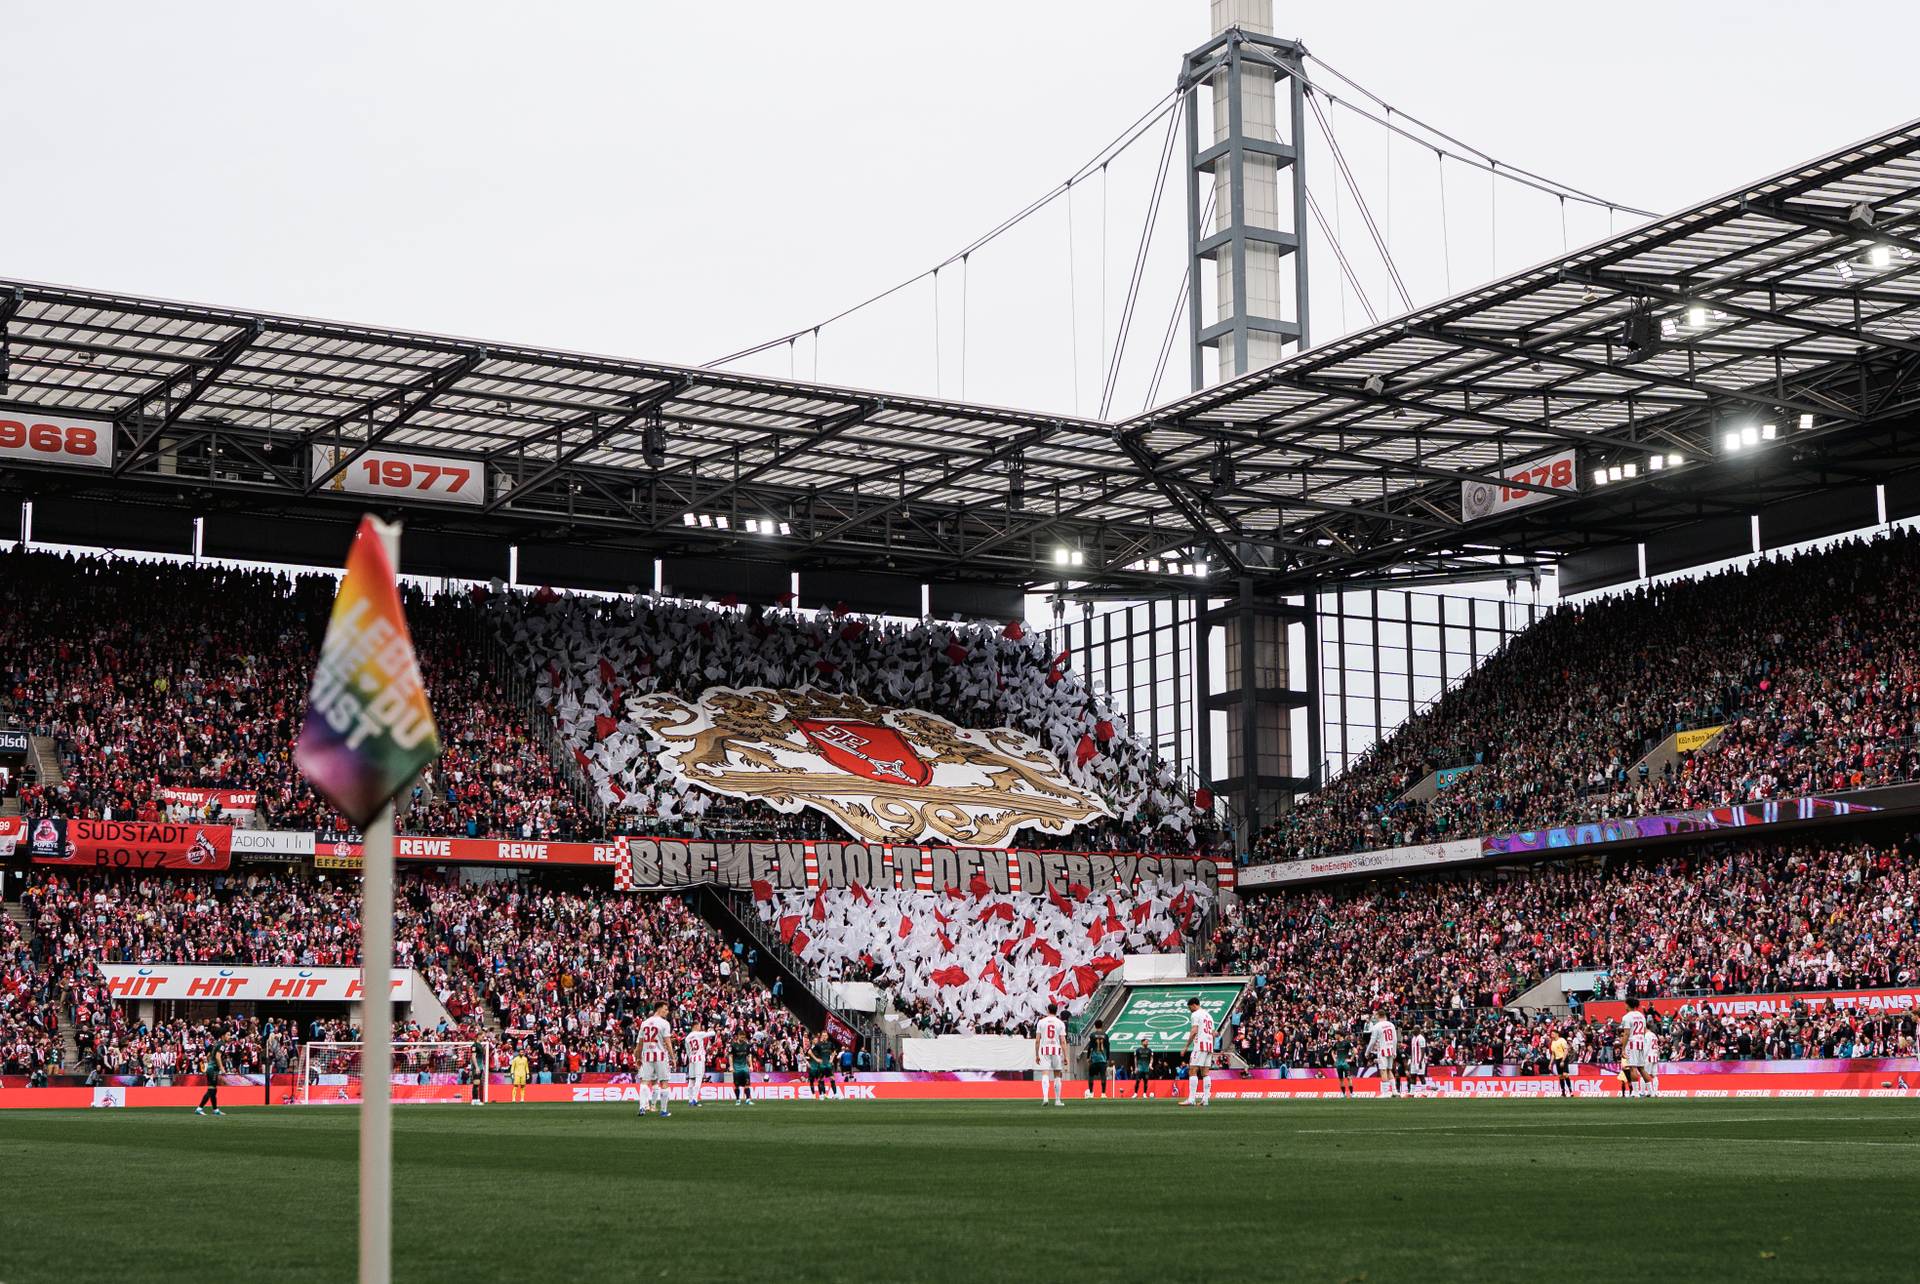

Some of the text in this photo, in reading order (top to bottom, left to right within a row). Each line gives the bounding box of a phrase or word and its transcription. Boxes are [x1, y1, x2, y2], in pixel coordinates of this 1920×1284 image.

[363, 459, 470, 493] 1977
[1499, 459, 1573, 503] 1978
[366, 685, 434, 749] DU
[231, 794, 257, 804] BOYZ
[231, 836, 275, 848] ADION
[323, 834, 363, 843] ALLEZ
[399, 839, 451, 856] REWE
[498, 843, 548, 859] REWE
[593, 846, 617, 862] RE
[96, 848, 167, 868] BOYZ
[317, 858, 363, 868] EFFZEH
[628, 839, 805, 890] BREMEN
[814, 842, 921, 891] HOLT
[930, 846, 1011, 894] DEN
[108, 976, 168, 996] HIT
[186, 978, 248, 996] HIT
[266, 979, 327, 997] HIT
[1133, 999, 1225, 1009] Bestns
[1858, 995, 1913, 1010] FANS
[643, 1026, 659, 1043] 32
[1047, 1025, 1055, 1039] 6
[1383, 1029, 1393, 1042] 18
[1633, 1021, 1644, 1035] 22
[689, 1039, 699, 1052] 13
[573, 1086, 697, 1102] ZESAM
[1461, 1081, 1499, 1092] DAT
